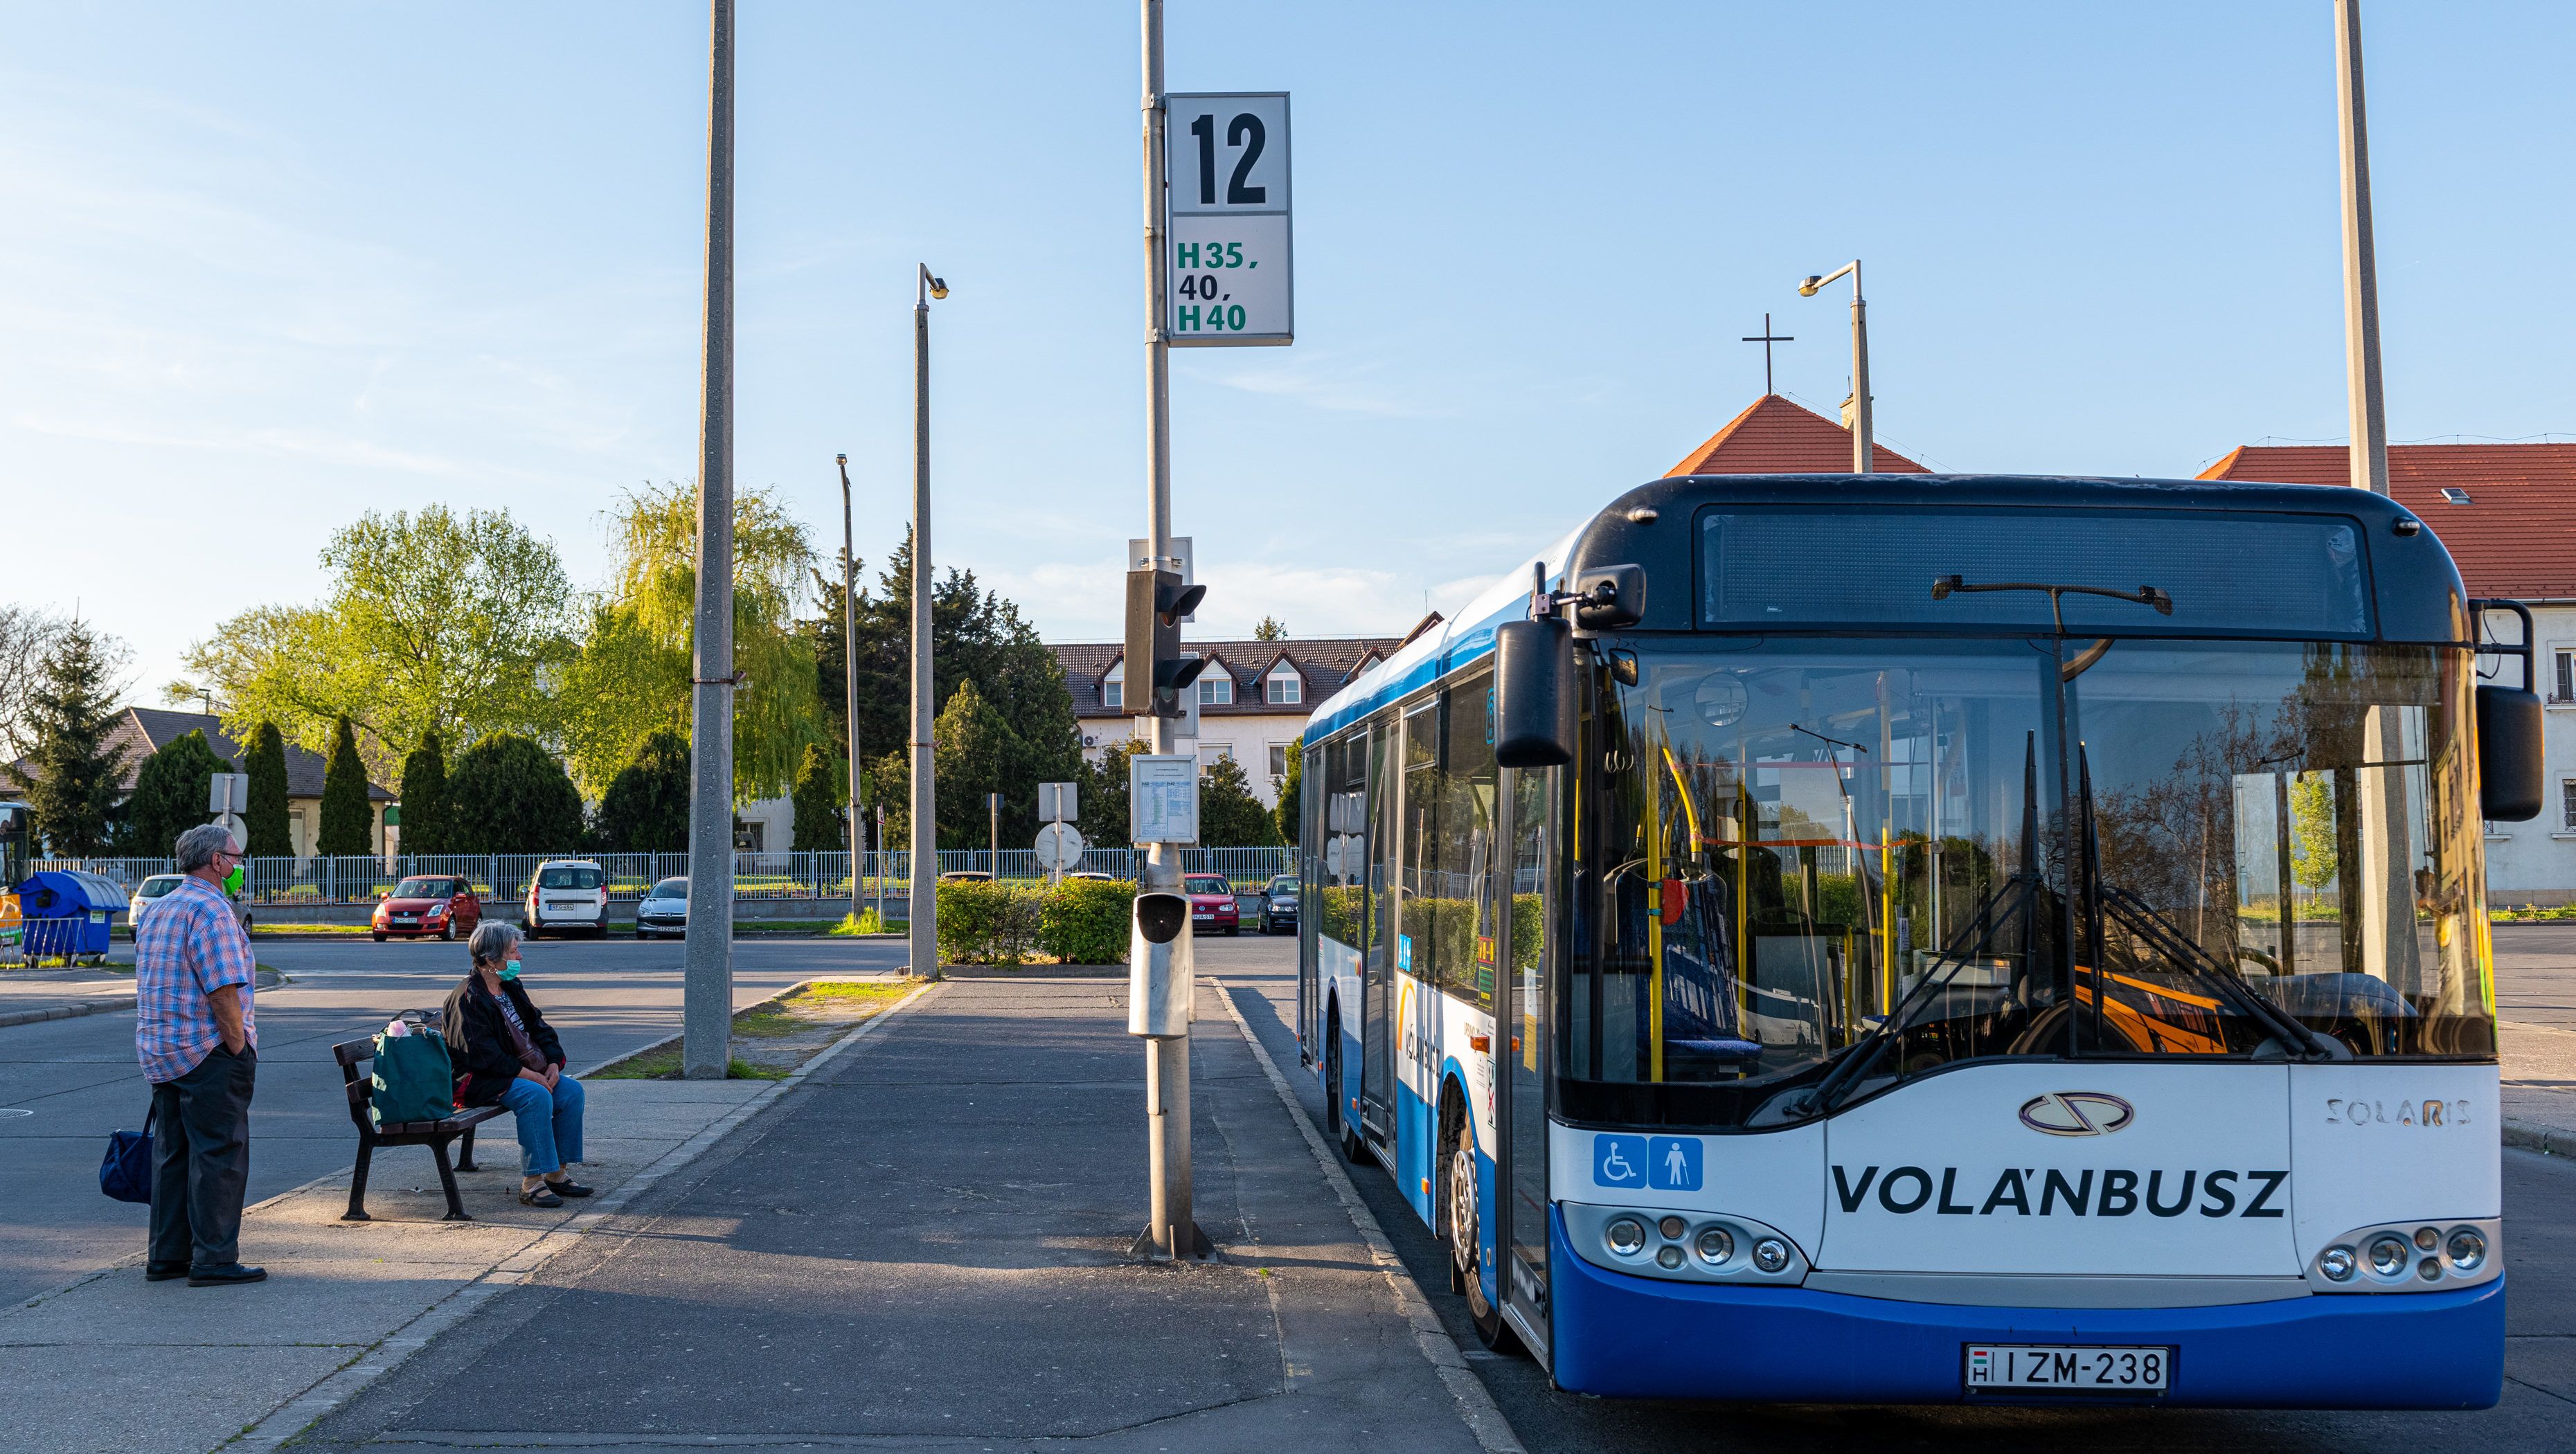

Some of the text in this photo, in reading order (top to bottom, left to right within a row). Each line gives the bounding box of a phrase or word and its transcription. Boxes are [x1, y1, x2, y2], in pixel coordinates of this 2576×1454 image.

[1191, 113, 1266, 204] 12
[1178, 242, 1258, 269] H35,
[1179, 275, 1231, 301] 40,
[1179, 305, 1246, 331] H40
[2325, 1098, 2471, 1127] SOLARIS
[1832, 1165, 2290, 1219] VOLÁNBUSZ
[1973, 1351, 2161, 1385] H IZM-238
